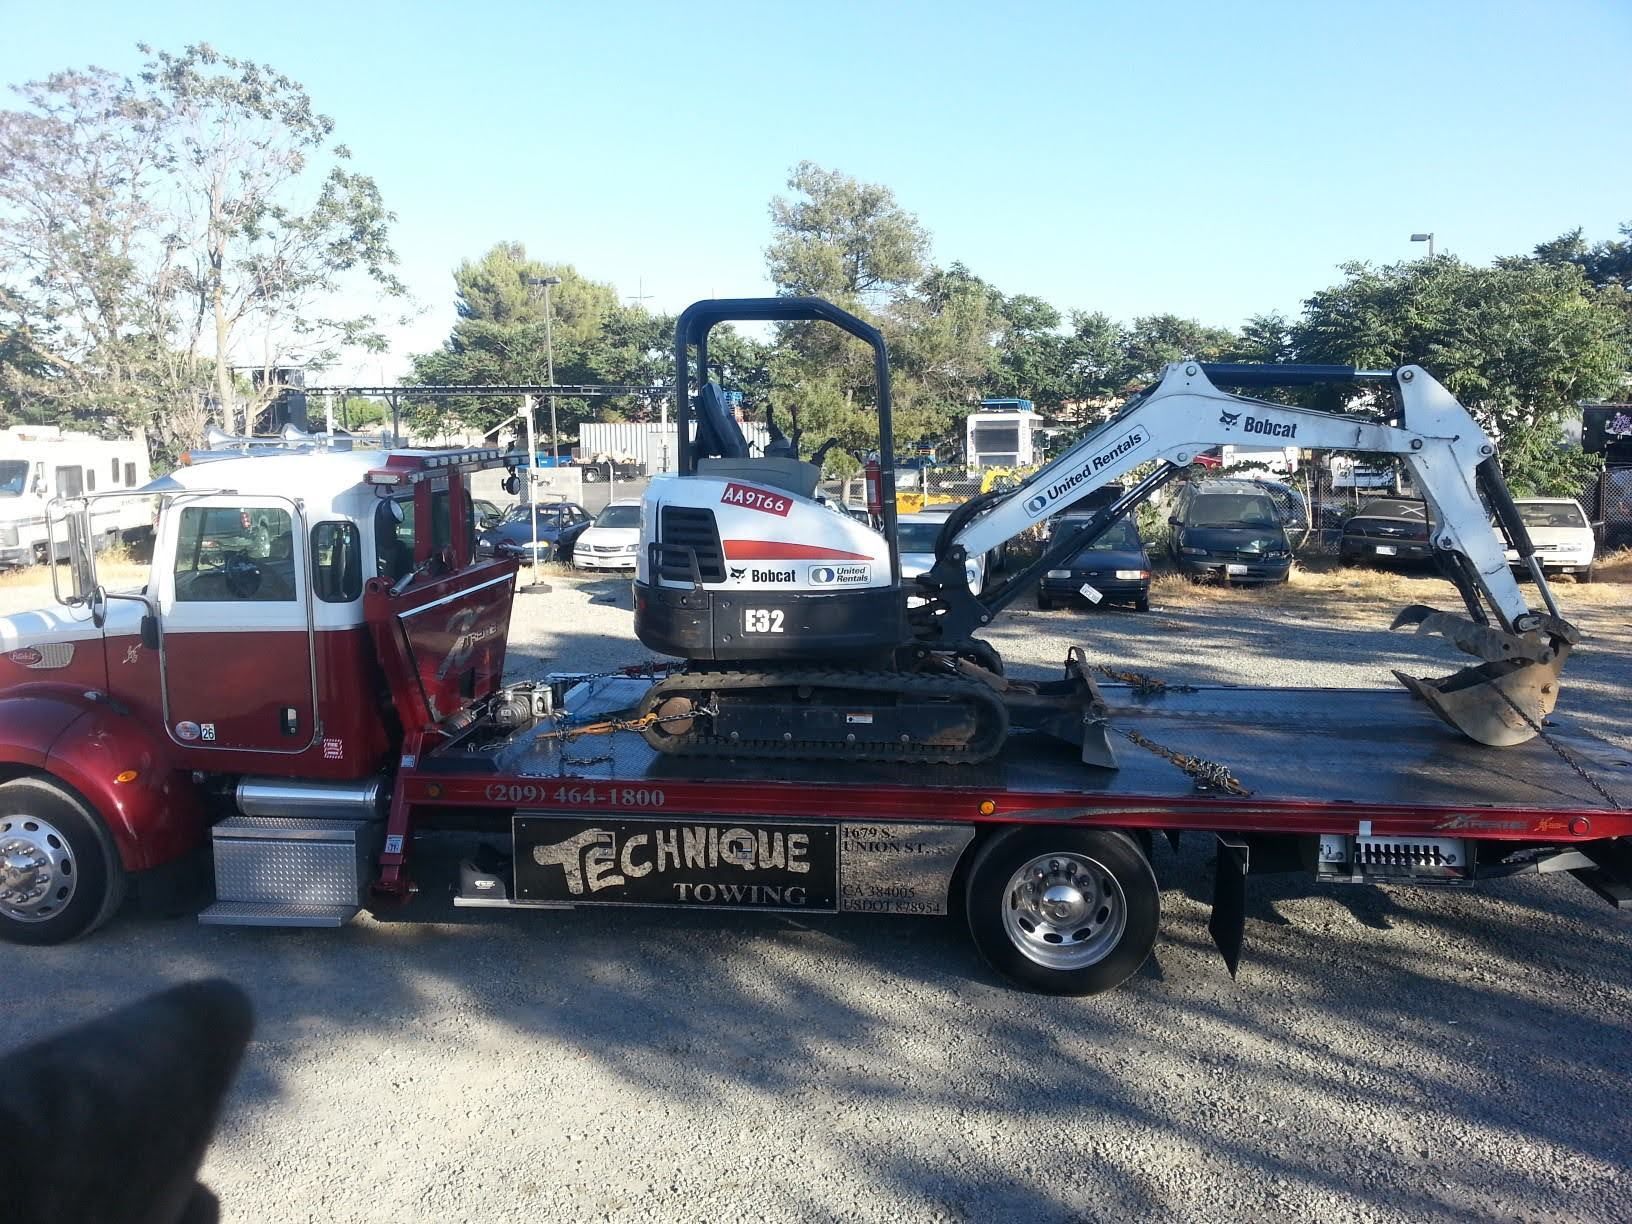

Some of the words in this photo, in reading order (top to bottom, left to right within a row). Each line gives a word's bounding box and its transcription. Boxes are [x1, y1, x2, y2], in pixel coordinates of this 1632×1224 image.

[1244, 416, 1297, 439] Bobcat
[1047, 464, 1092, 500] United
[1092, 432, 1142, 470] Rentals
[752, 569, 796, 583] Bobcat
[836, 566, 866, 575] United
[836, 574, 869, 583] Rentals
[745, 609, 785, 633] E32
[202, 728, 215, 740] 26
[485, 784, 546, 802] (209)
[553, 786, 665, 807] 464-1800
[844, 841, 900, 853] UNION
[533, 826, 811, 896] TECHNIQUE
[673, 883, 806, 905] TOWING
[843, 900, 890, 912] USDOT
